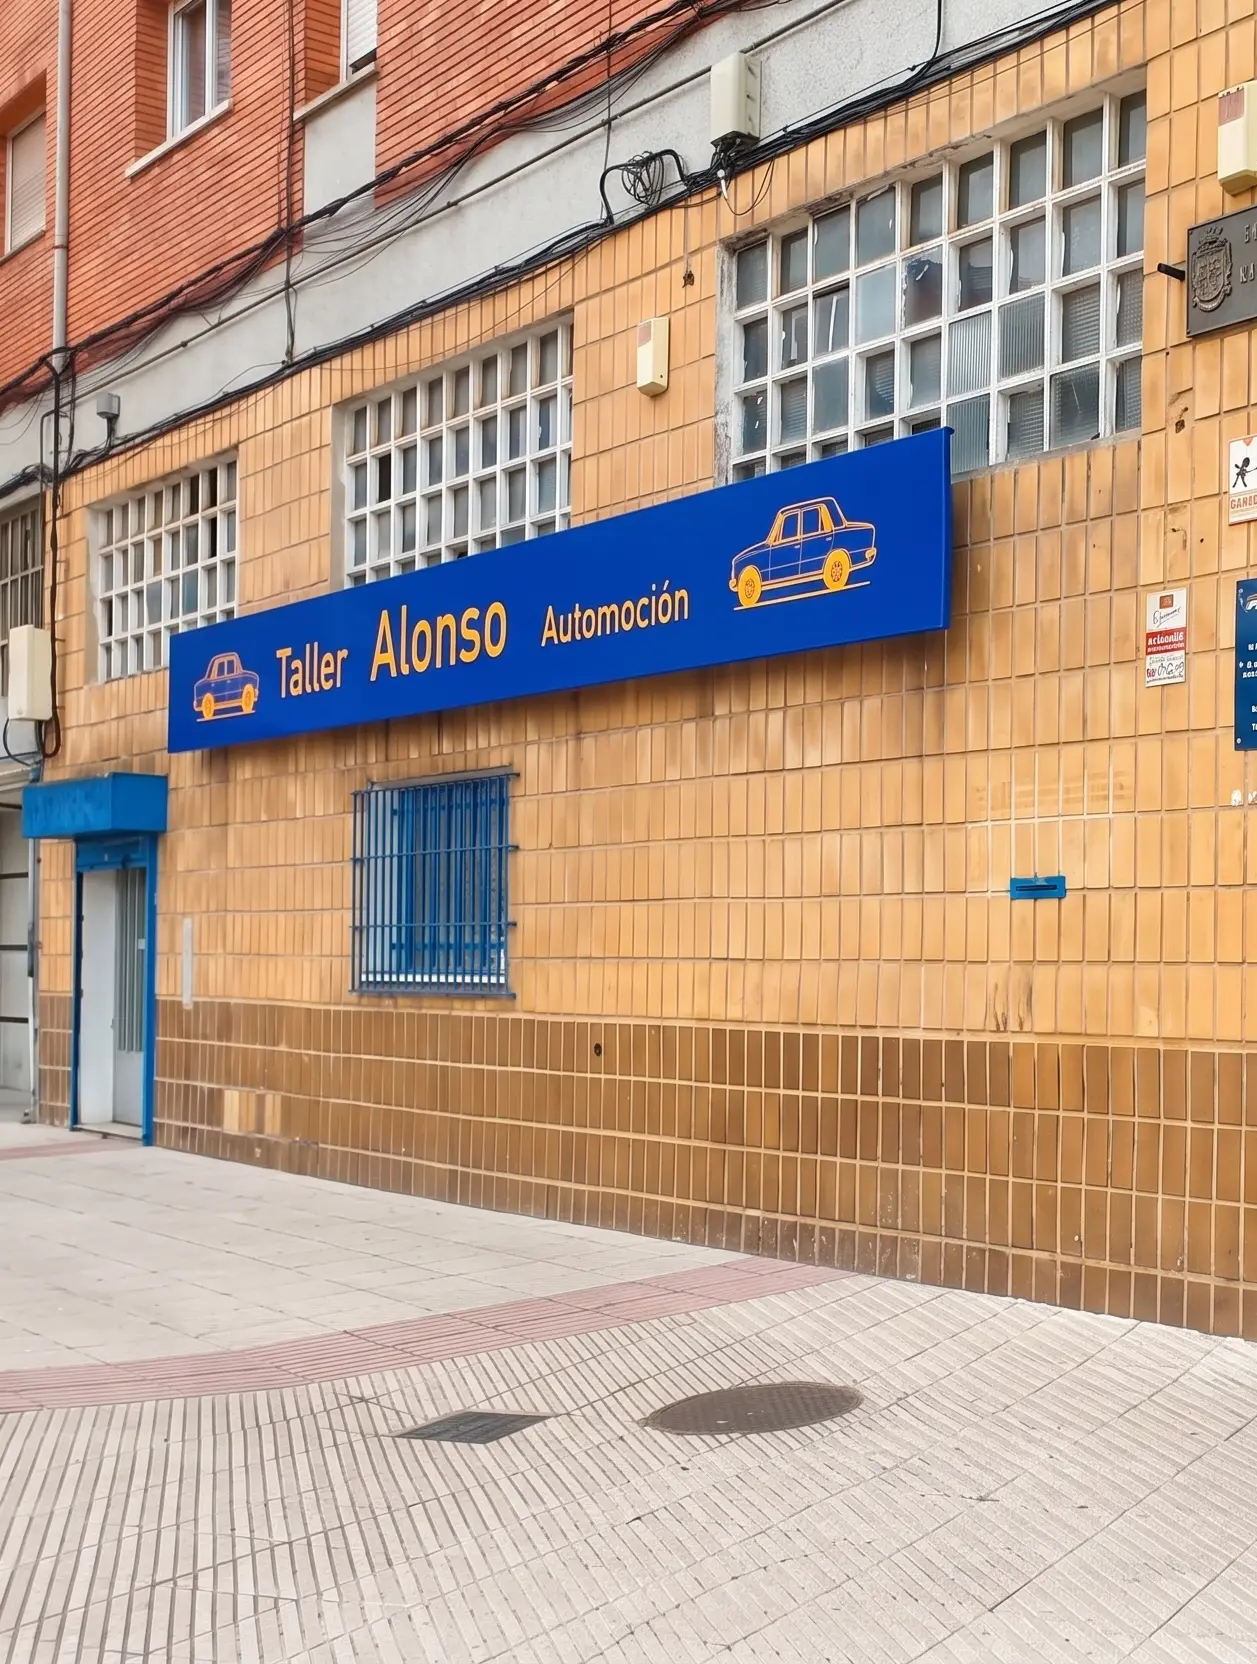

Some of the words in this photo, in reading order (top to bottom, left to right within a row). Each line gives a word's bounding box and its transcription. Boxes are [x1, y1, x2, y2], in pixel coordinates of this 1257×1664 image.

[276, 641, 349, 698] Taller
[369, 600, 508, 682] Alonso
[540, 579, 690, 648] Automoción
